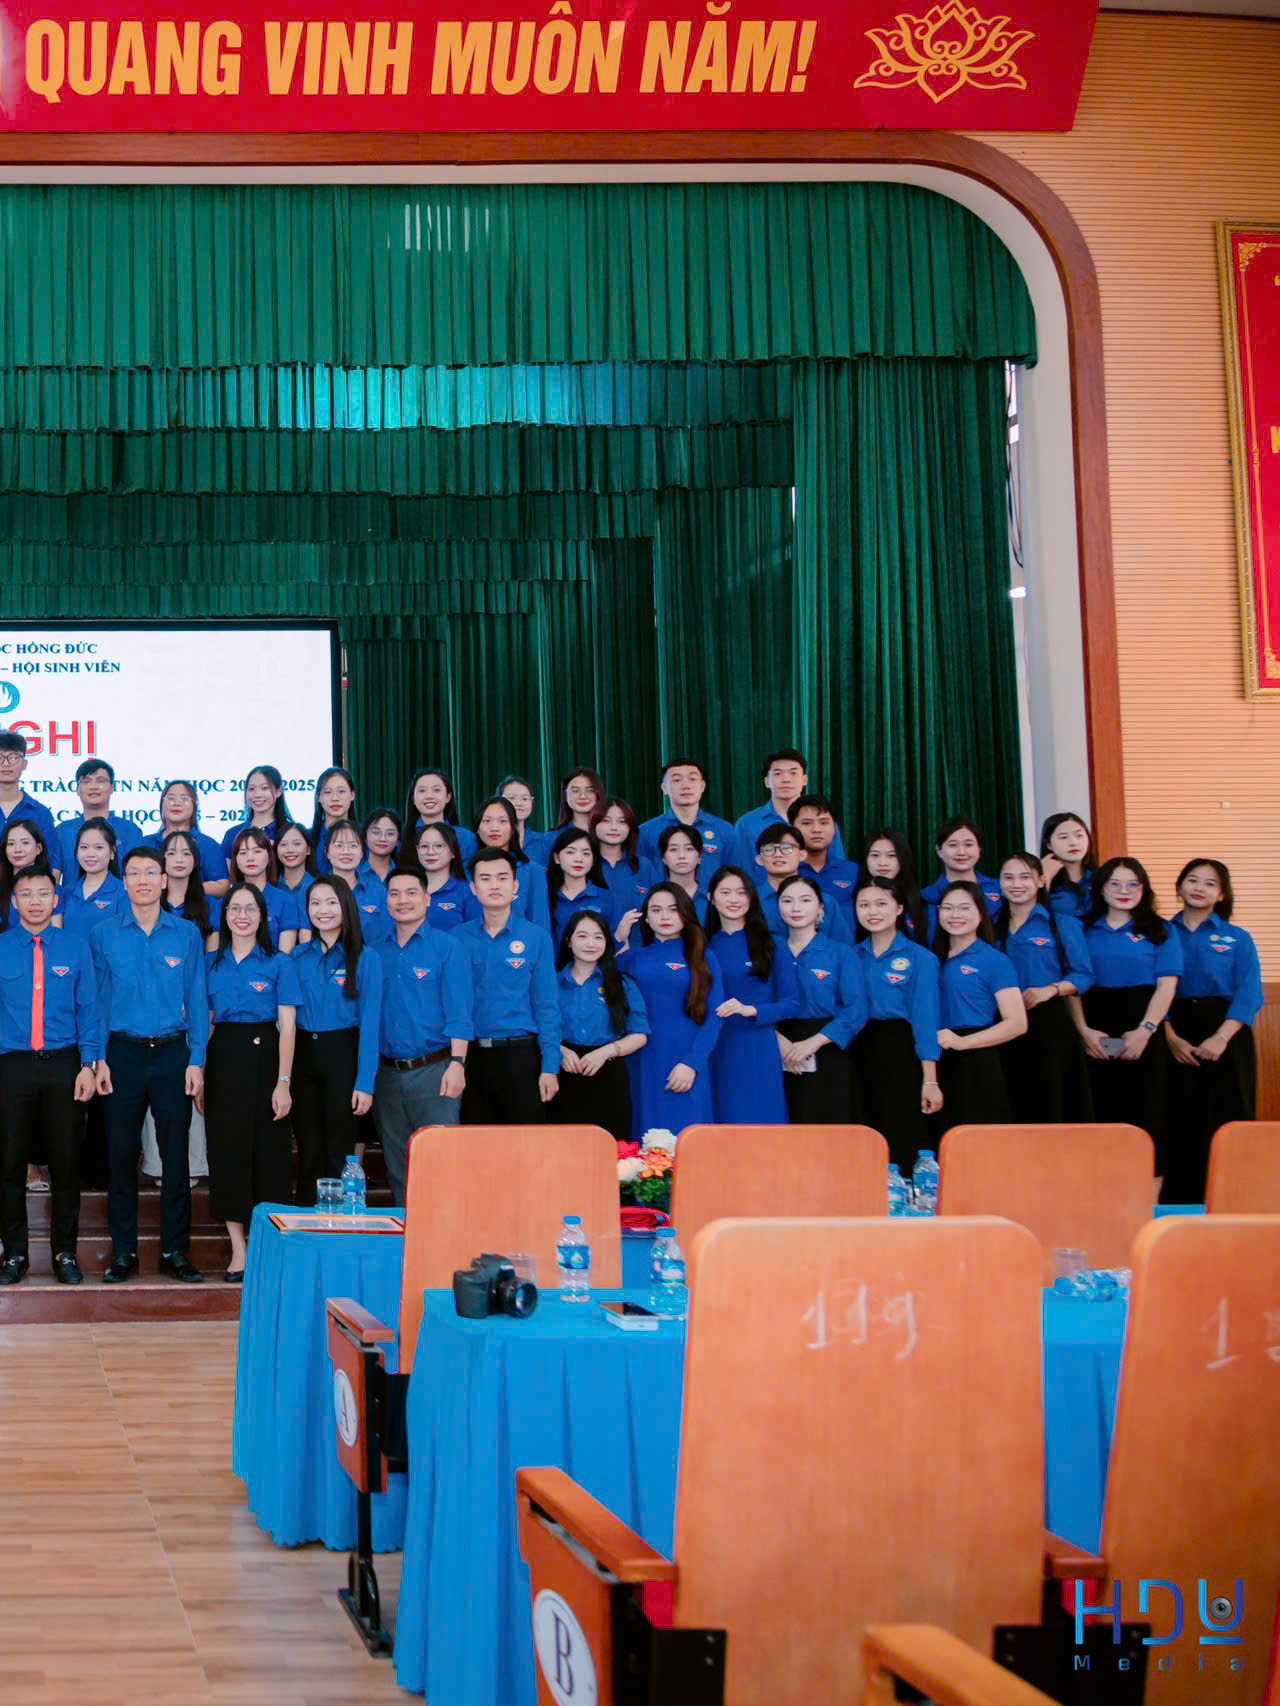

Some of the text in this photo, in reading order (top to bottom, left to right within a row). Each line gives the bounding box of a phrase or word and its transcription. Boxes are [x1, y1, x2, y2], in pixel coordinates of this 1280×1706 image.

[24, 18, 242, 104] QUANG
[263, 20, 414, 96] VINH
[430, 0, 627, 96] MUÔN
[639, 0, 818, 95] NĂM!
[12, 660, 41, 676] HỘI
[44, 662, 81, 674] SINH
[83, 659, 121, 674] VIÊN
[64, 640, 99, 655] ĐỨC
[551, 1609, 574, 1697] B
